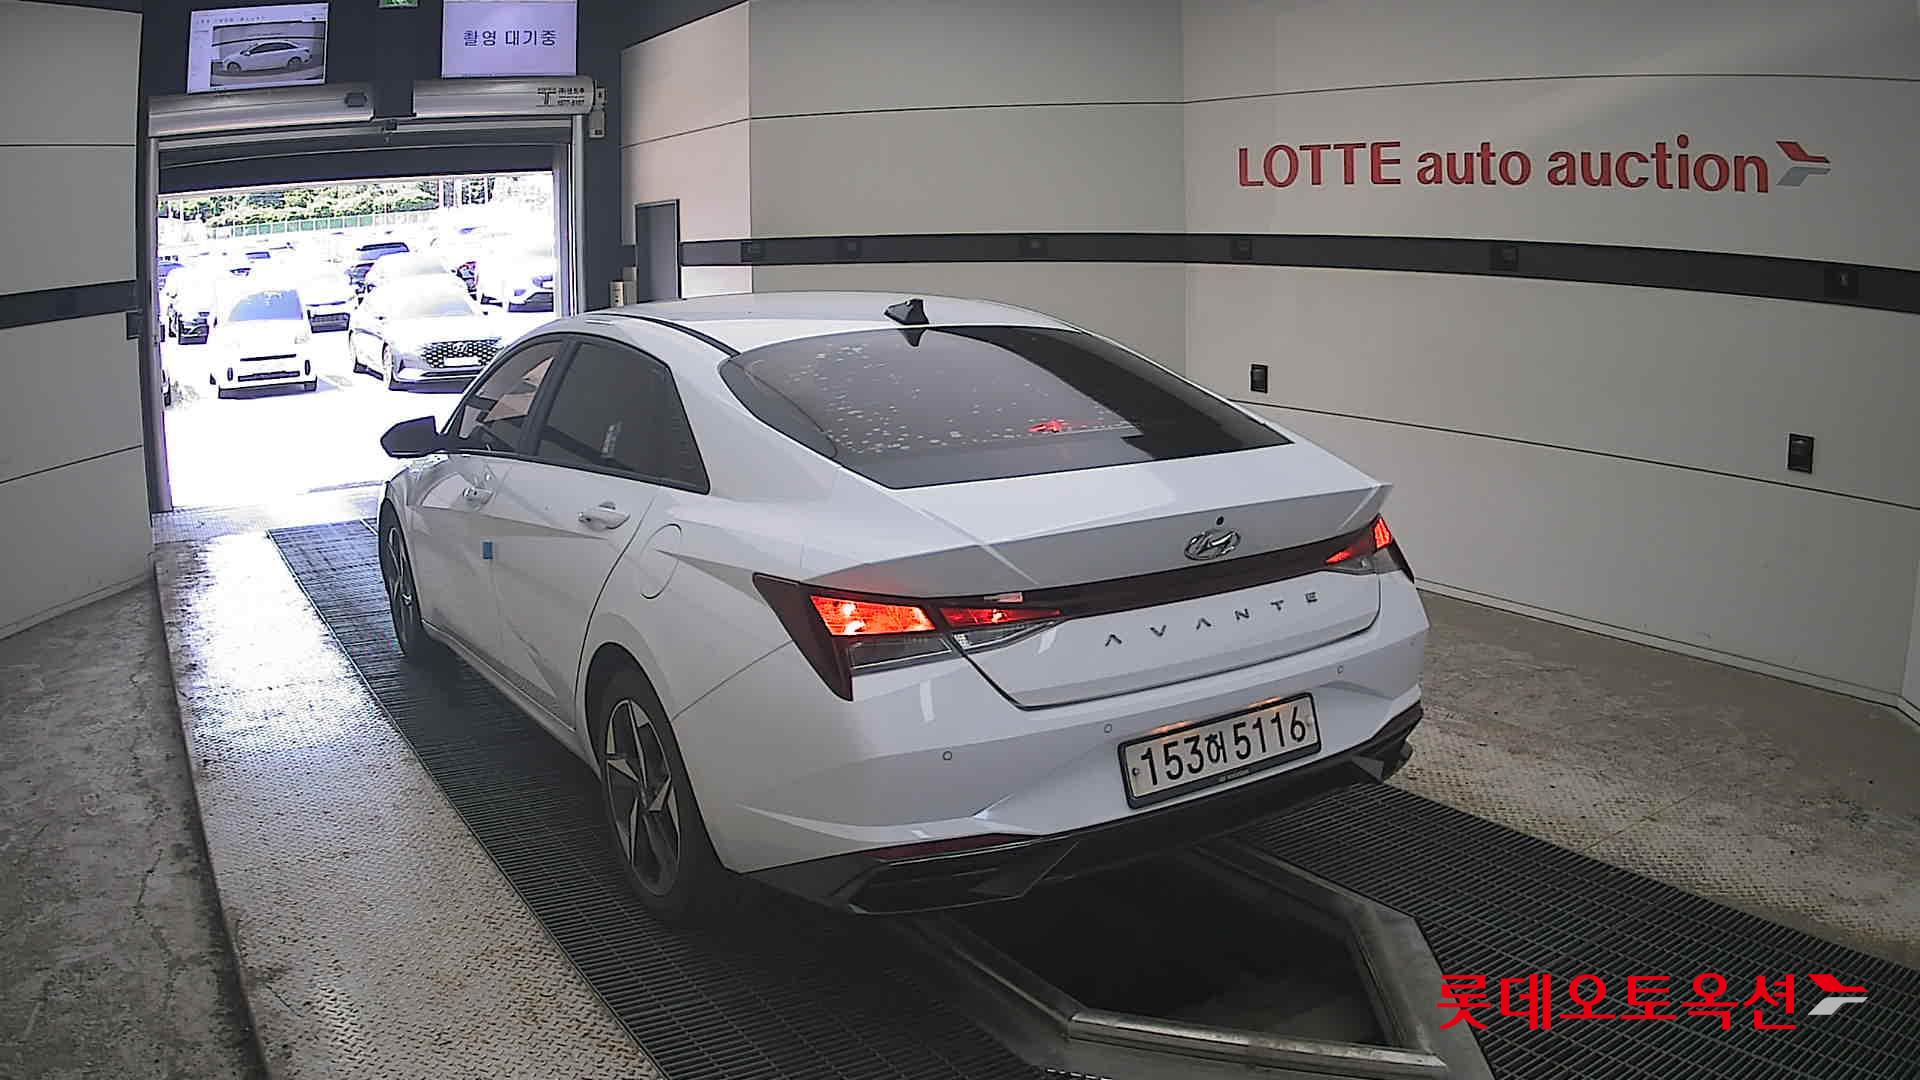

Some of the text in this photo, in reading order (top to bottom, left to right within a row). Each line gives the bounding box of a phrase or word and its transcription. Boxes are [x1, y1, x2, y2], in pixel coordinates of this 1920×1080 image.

[463, 30, 557, 47] 촬영 대기중
[1238, 134, 1769, 194] LOTTE auto auction
[1104, 591, 1318, 648] AVANTE
